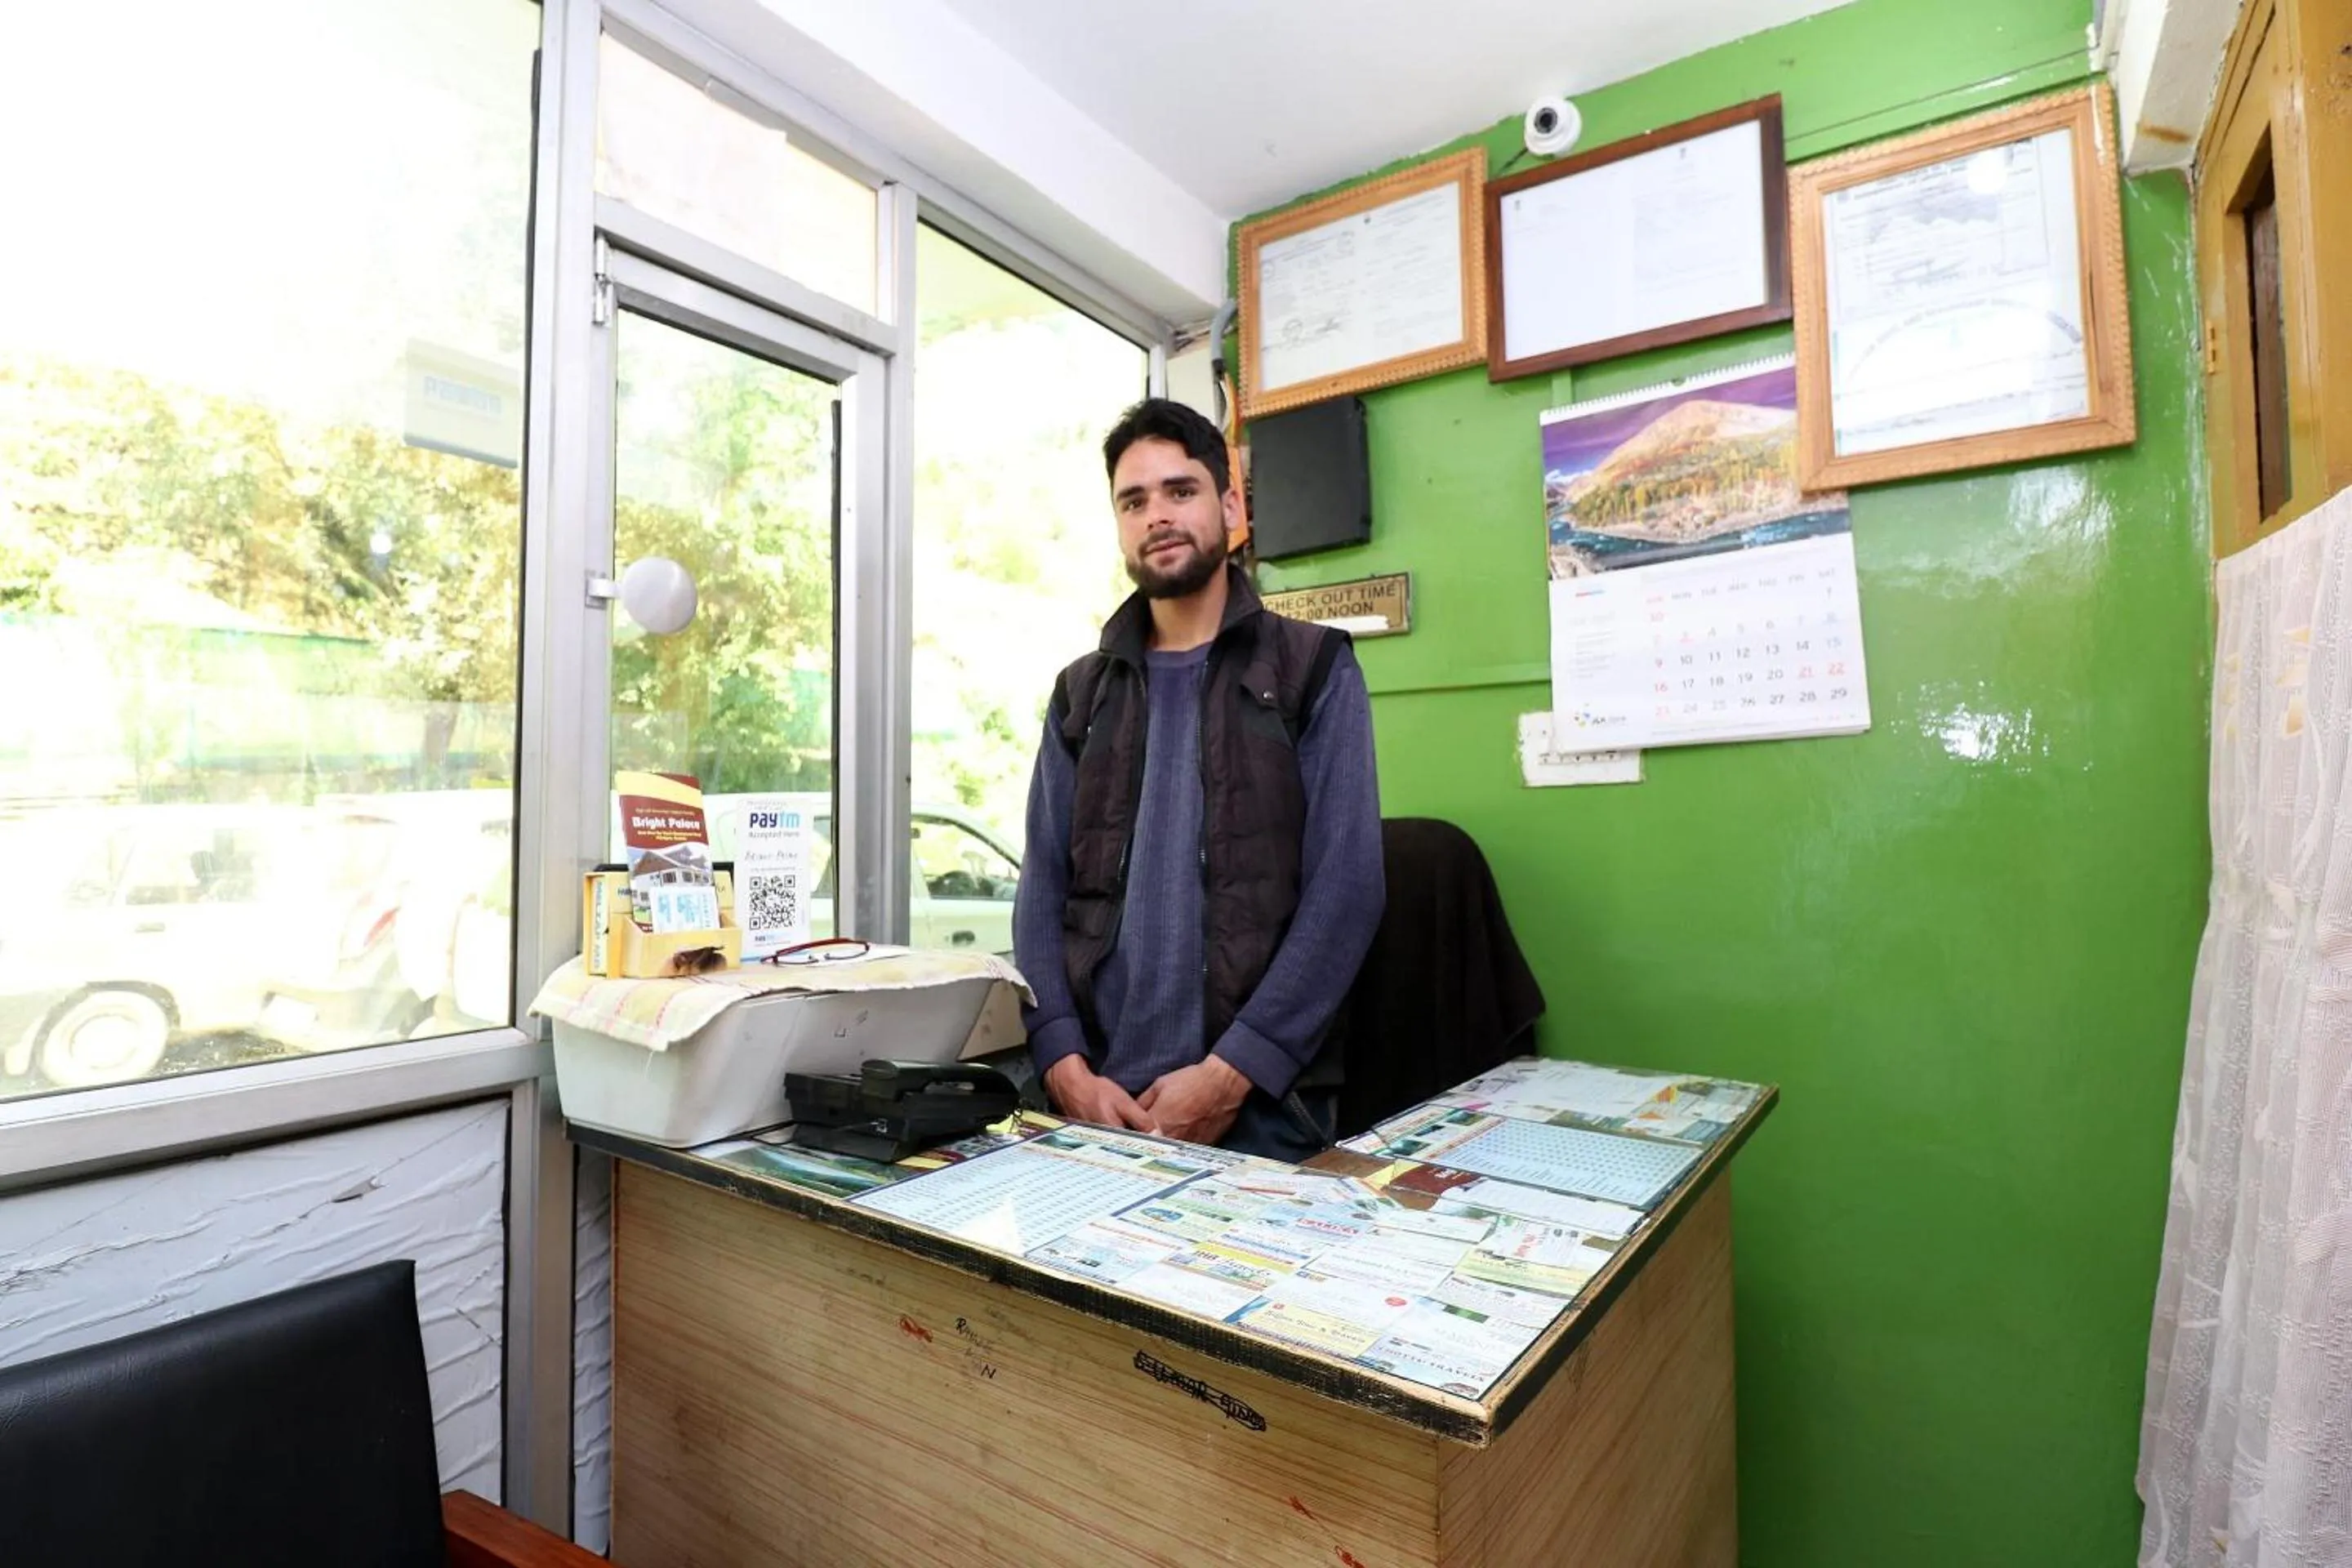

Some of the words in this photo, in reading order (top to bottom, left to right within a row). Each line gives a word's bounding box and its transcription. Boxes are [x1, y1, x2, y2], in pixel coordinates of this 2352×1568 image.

[1265, 595, 1316, 611] CHECK
[1321, 590, 1353, 605] OUT
[1360, 582, 1396, 599] TIME
[1328, 601, 1374, 617] NOON
[1655, 657, 1664, 669] 9
[1680, 654, 1693, 666] 10
[1708, 651, 1722, 664] 11
[1736, 647, 1751, 659] 12
[1765, 644, 1780, 656] 13
[1796, 639, 1810, 652] 14
[1826, 635, 1842, 648] 15
[1655, 681, 1668, 693] 16
[1682, 678, 1695, 689] 17
[1709, 675, 1725, 688] 18
[1738, 671, 1753, 684] 19
[1766, 668, 1784, 681] 20
[1798, 666, 1814, 679] 21
[1828, 662, 1846, 676] 22
[1682, 702, 1699, 714] 24
[1740, 696, 1757, 708] 26
[1769, 693, 1785, 705] 27
[1799, 690, 1817, 703] 28
[1830, 687, 1848, 700] 29
[632, 816, 666, 831] Bright
[748, 831, 782, 841] Accepted
